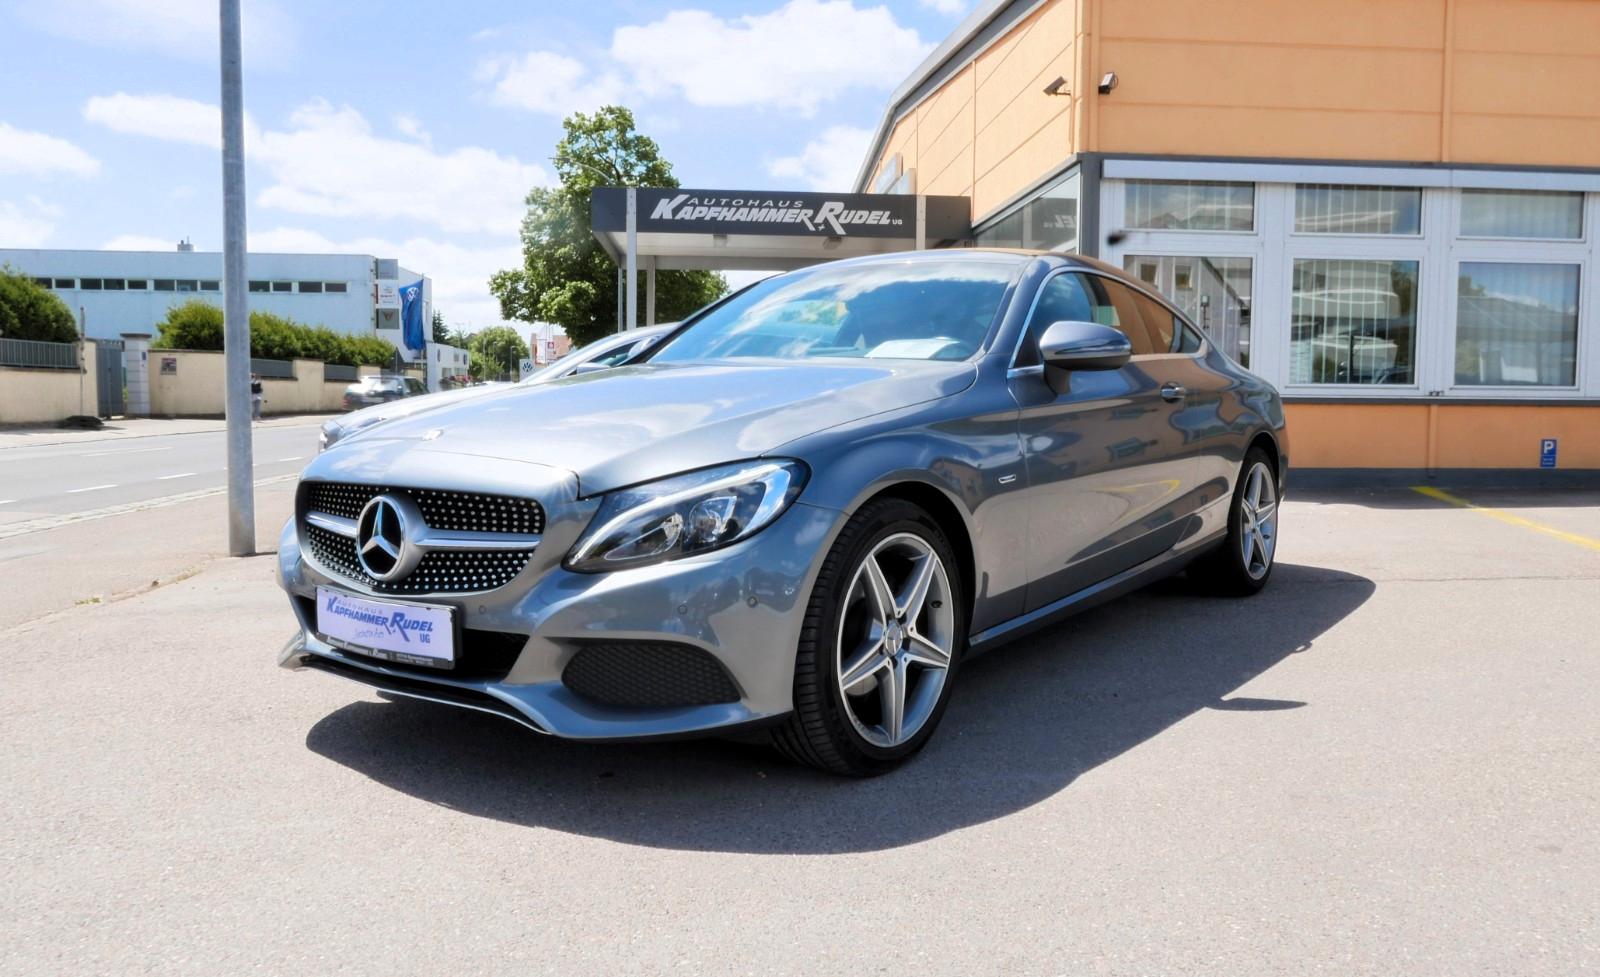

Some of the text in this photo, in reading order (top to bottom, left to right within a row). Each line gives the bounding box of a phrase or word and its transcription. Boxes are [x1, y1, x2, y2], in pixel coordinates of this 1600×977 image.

[687, 197, 804, 208] AUTOHAUS
[650, 194, 816, 231] KAPFHAMMER
[814, 201, 891, 235] RUDEL
[1544, 441, 1554, 454] P
[327, 596, 391, 635] KAPFHAMMER
[390, 612, 433, 642] RUDEL
[419, 633, 431, 643] UG
